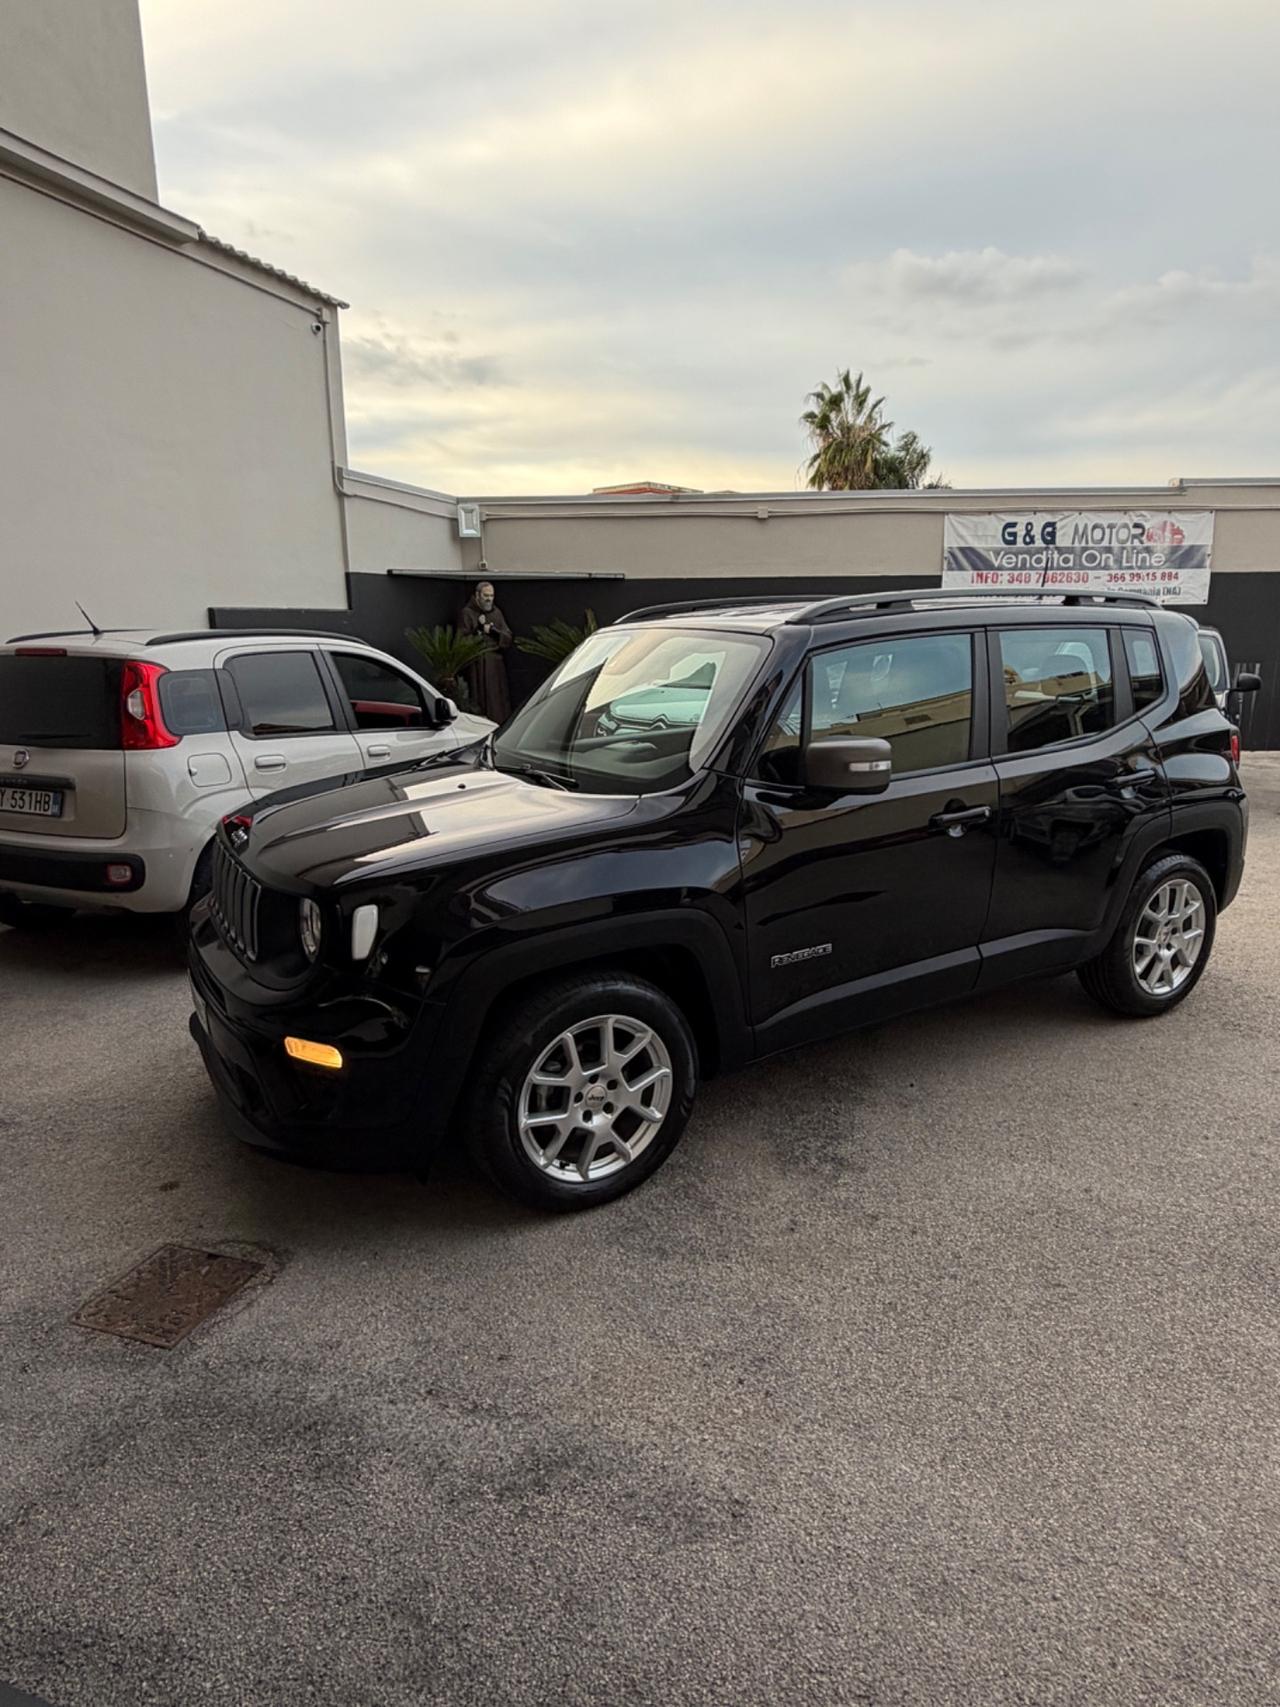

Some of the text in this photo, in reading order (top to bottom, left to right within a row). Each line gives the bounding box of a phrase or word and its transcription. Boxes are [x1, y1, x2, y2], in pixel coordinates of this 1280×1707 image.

[1071, 522, 1146, 546] MOTOR
[990, 549, 1166, 568] Vendita On Line
